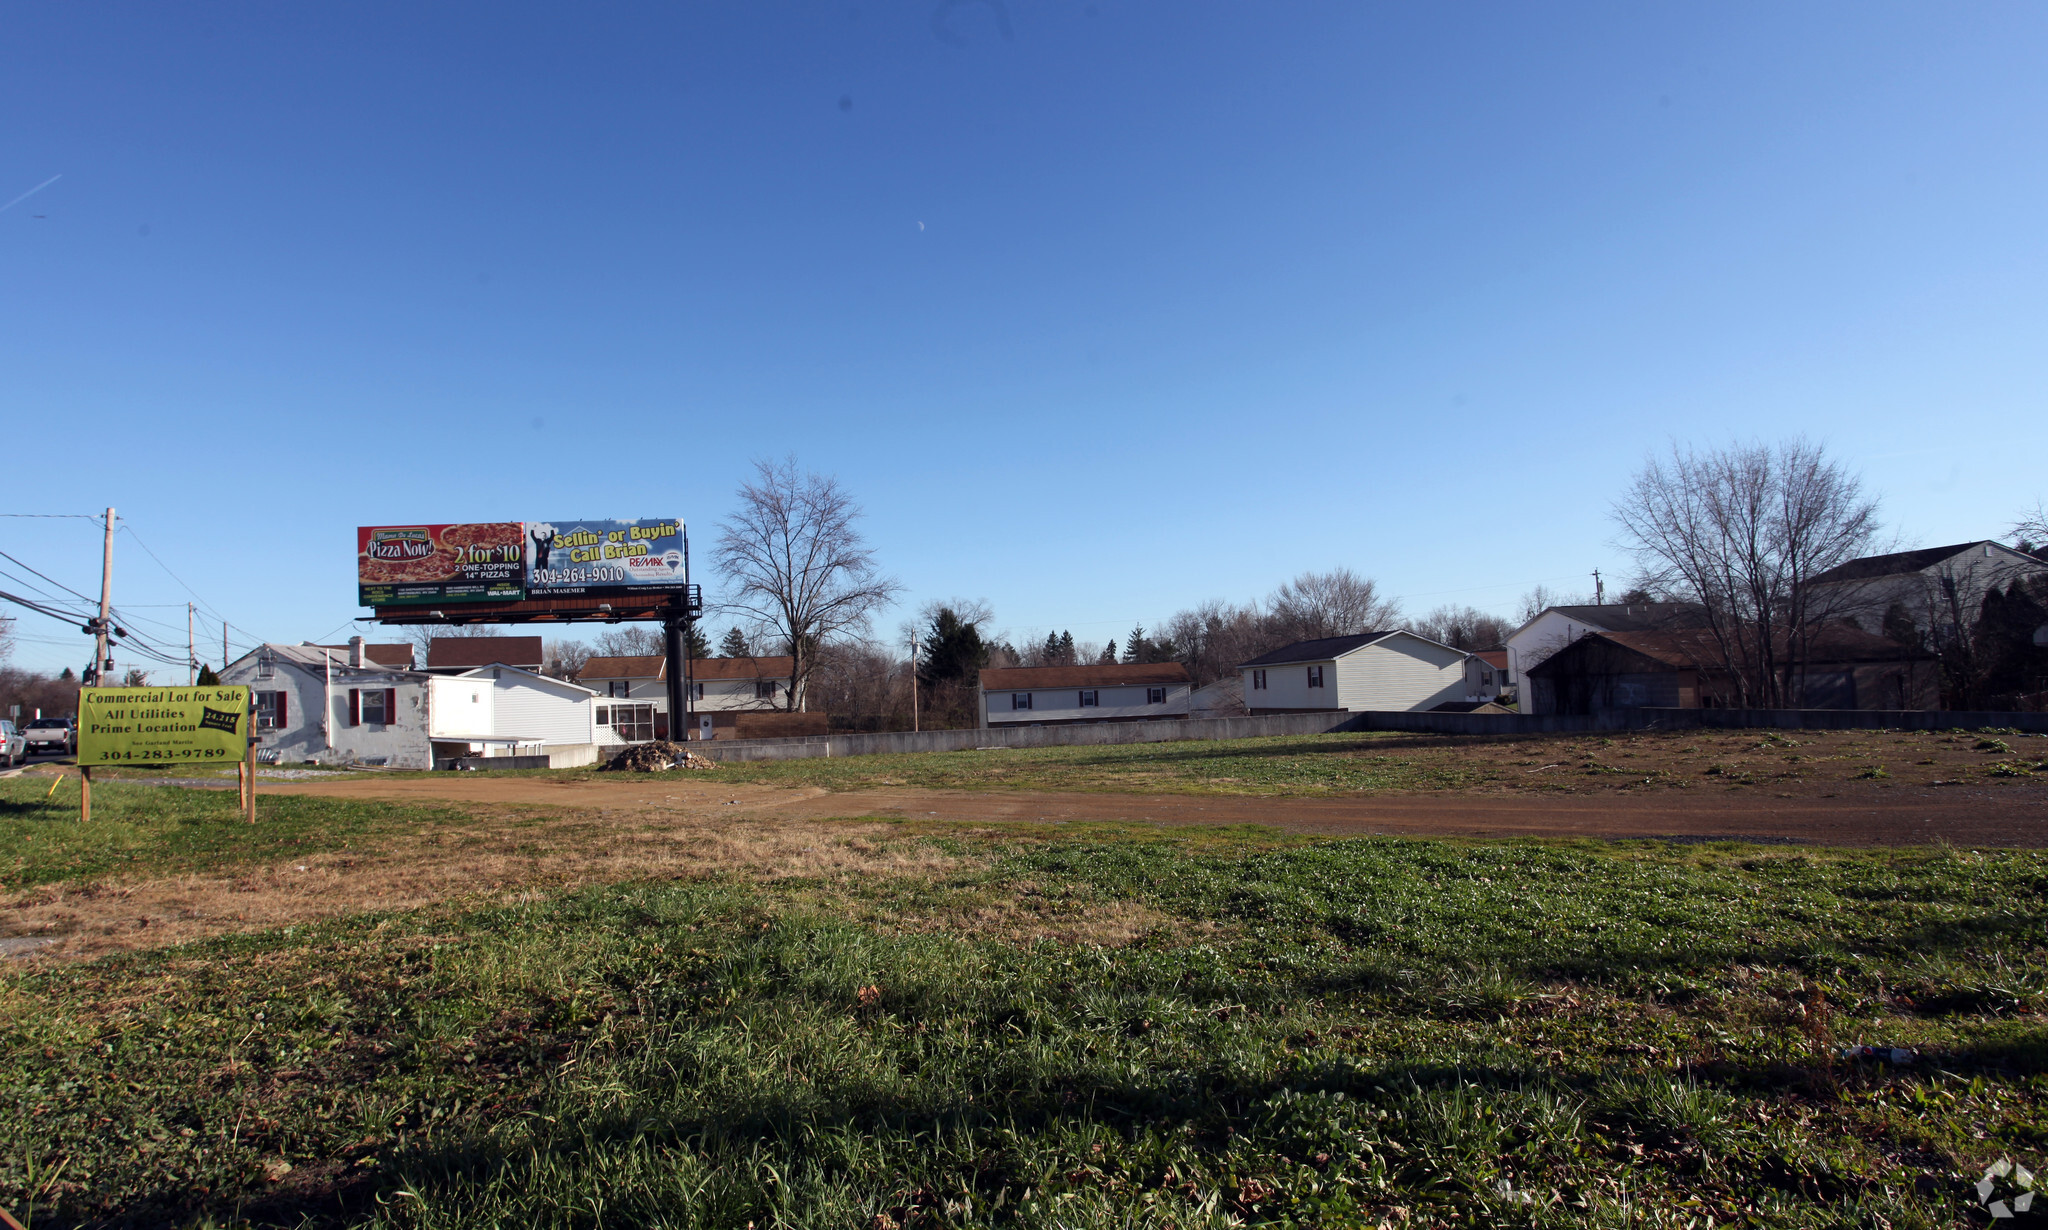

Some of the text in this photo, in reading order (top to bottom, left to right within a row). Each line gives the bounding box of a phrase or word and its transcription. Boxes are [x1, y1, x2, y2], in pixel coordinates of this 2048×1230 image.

[553, 522, 680, 549] Sellin' or Buyin'
[370, 540, 432, 558] Pizza Now!
[454, 544, 520, 563] 2 for $10
[570, 543, 648, 563] Call Brian
[462, 563, 520, 571] ONE-TOPPING
[630, 557, 664, 567] RE/MAX
[532, 566, 624, 584] 304-264-9010
[87, 690, 242, 704] Commercial Lot for Sale
[105, 709, 185, 719] All Utilities
[91, 723, 196, 734] Prime Location
[100, 749, 226, 760] 304-283-9789
